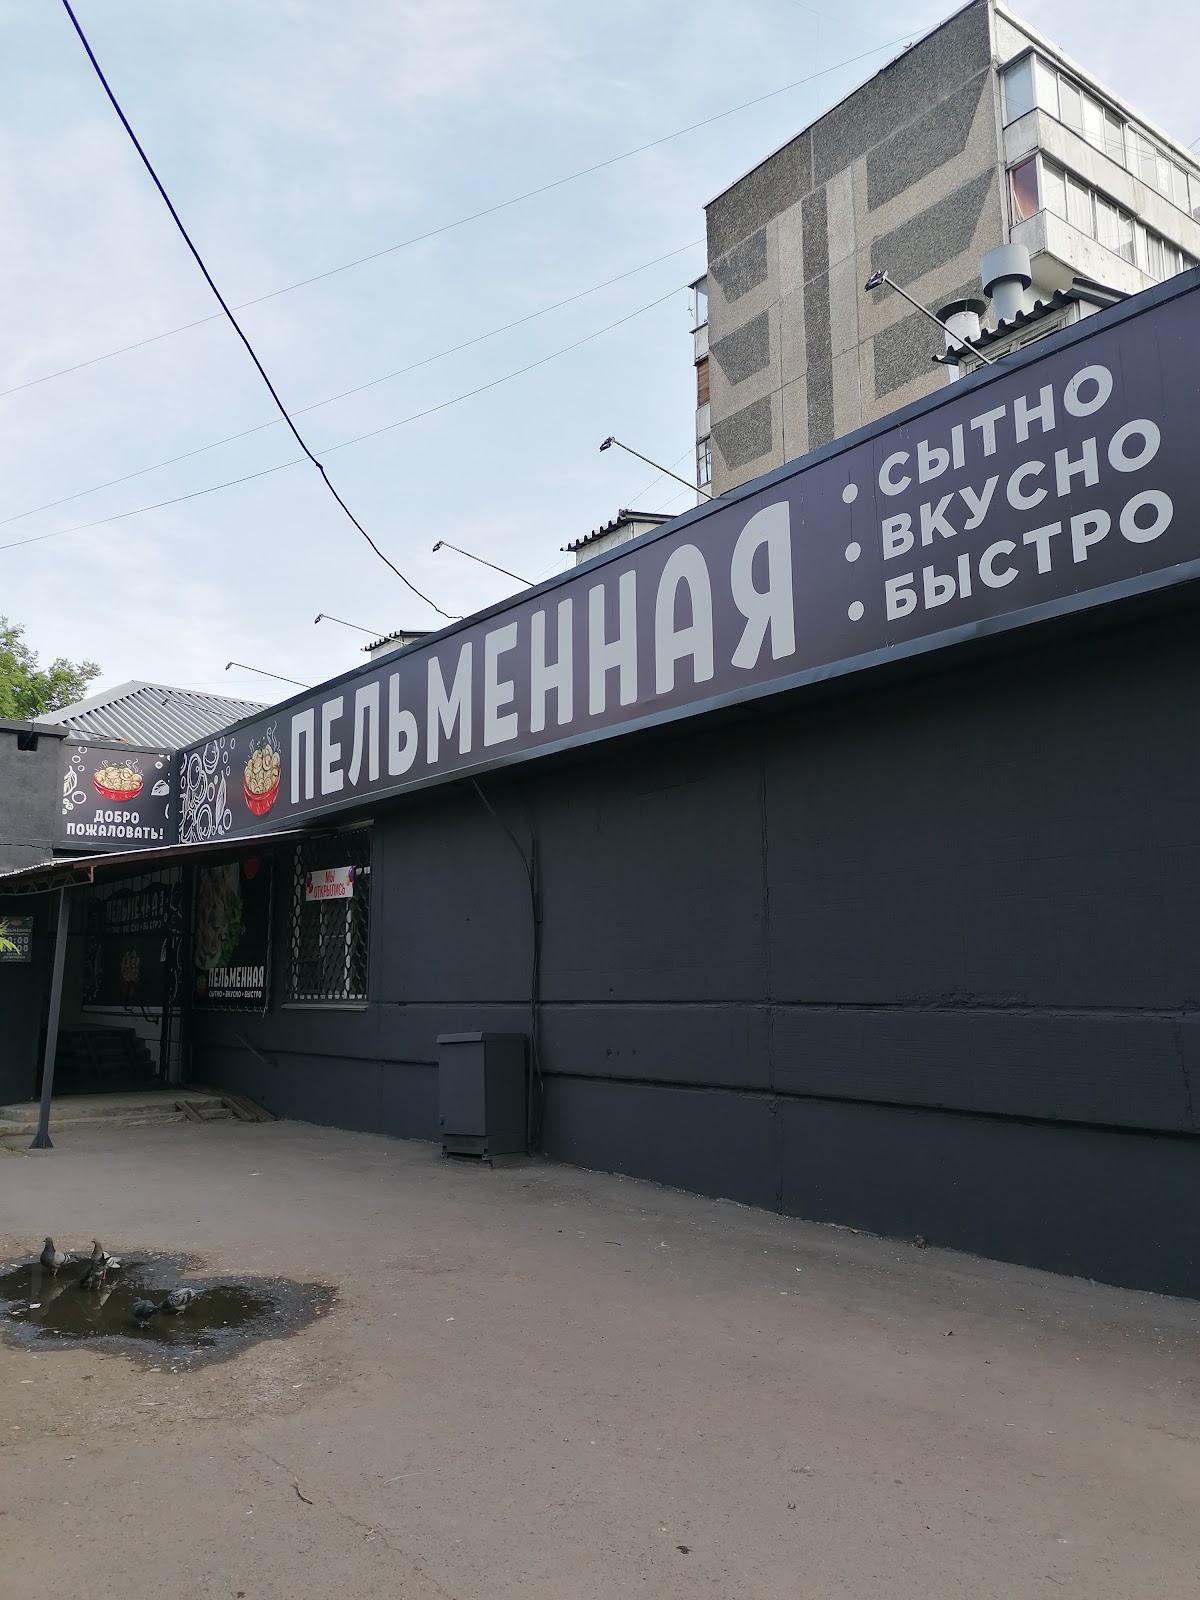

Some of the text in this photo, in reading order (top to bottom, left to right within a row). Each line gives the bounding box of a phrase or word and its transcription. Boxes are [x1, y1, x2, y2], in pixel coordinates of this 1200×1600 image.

[878, 364, 1114, 497] СЫТНО
[881, 418, 1161, 560] ВКУСНО
[885, 489, 1174, 621] БЫСТРО
[290, 501, 797, 804] ПЕЛЬМЕННАЯ
[93, 809, 140, 824] ДОБРО
[66, 822, 164, 840] ПОЖАЛОВАТЬ!
[325, 870, 336, 883] МЫ
[313, 883, 346, 898] ОТКРЫЛИСЬ
[208, 965, 265, 988] ПЕЛЬМЕННАЯ
[244, 990, 262, 999] БЫСТРО
